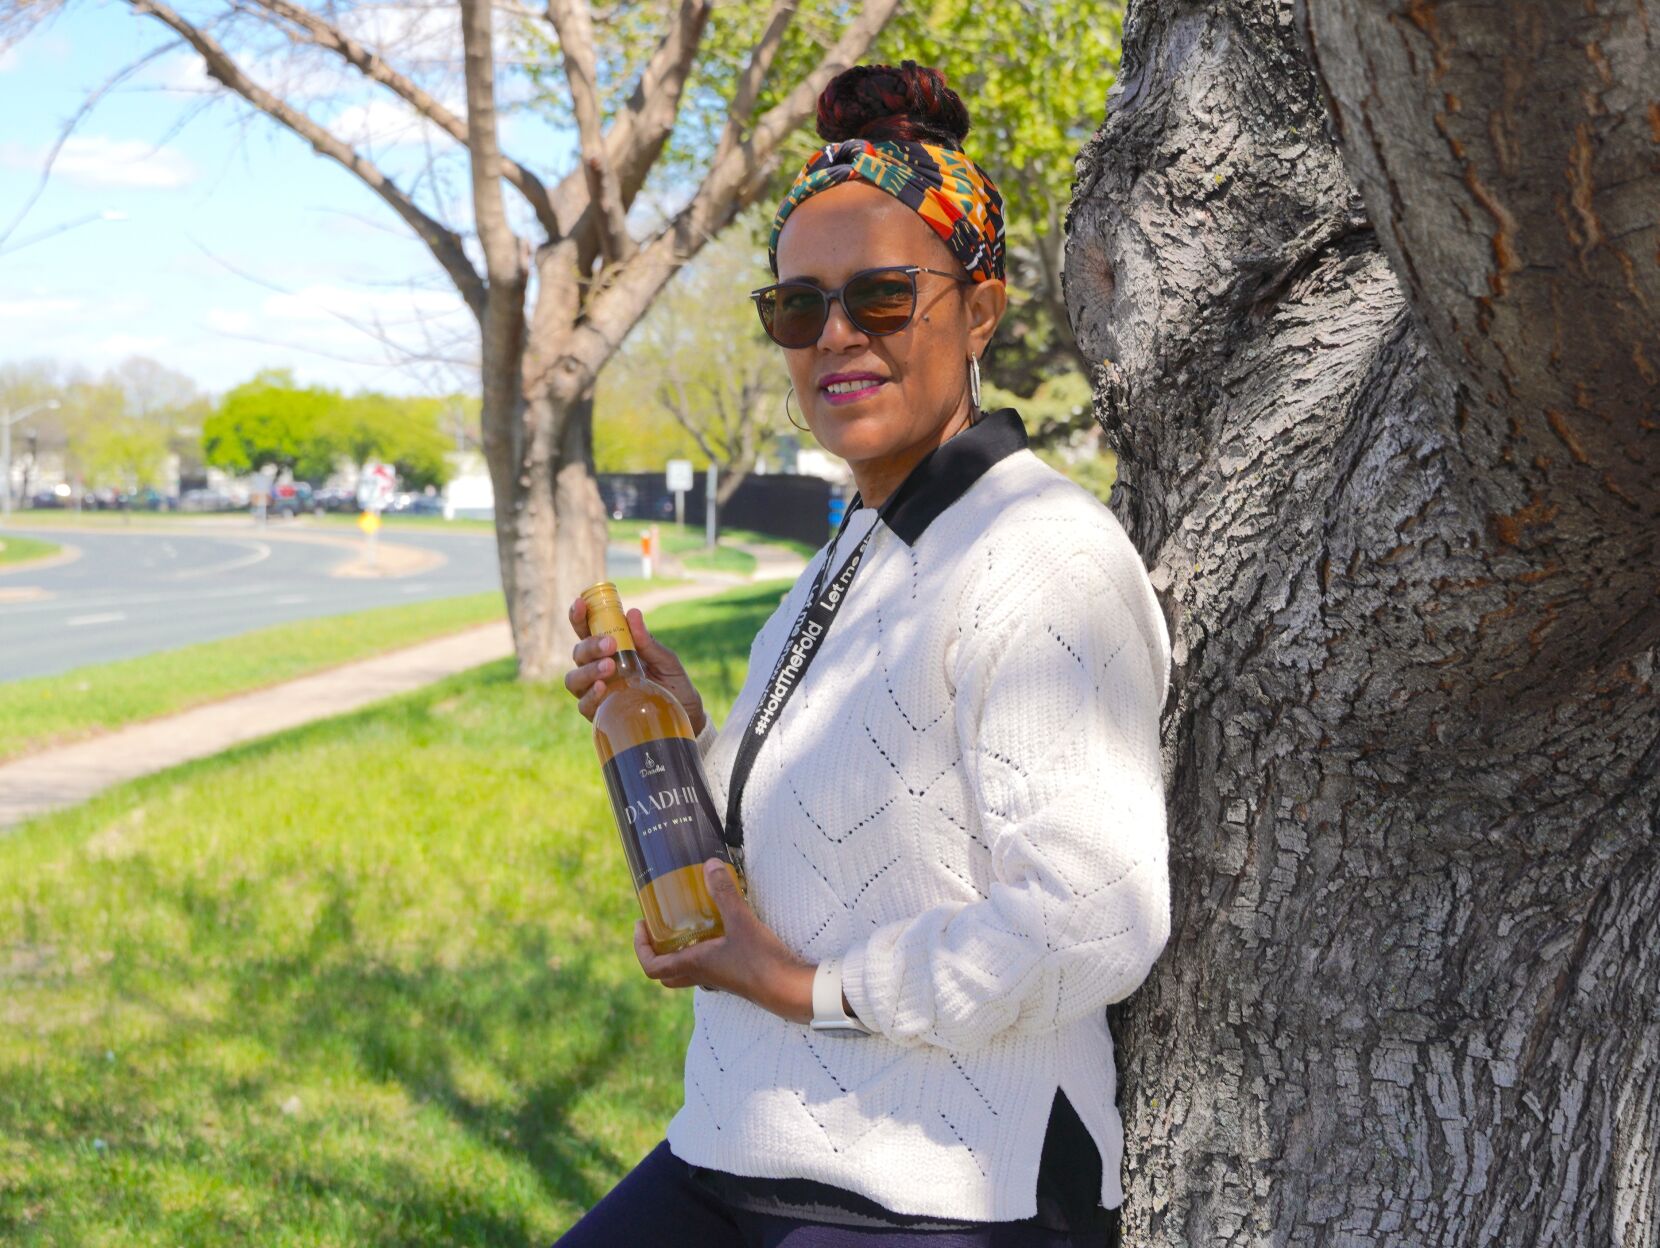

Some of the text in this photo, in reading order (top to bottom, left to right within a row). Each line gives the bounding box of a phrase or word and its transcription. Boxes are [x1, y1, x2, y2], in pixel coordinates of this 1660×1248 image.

[791, 611, 807, 637] me
[755, 620, 823, 735] #HoldTheFold
[820, 583, 845, 611] Let
[840, 556, 860, 584] me
[625, 786, 698, 824] DAADHII
[643, 815, 693, 836] HONEY WINE
